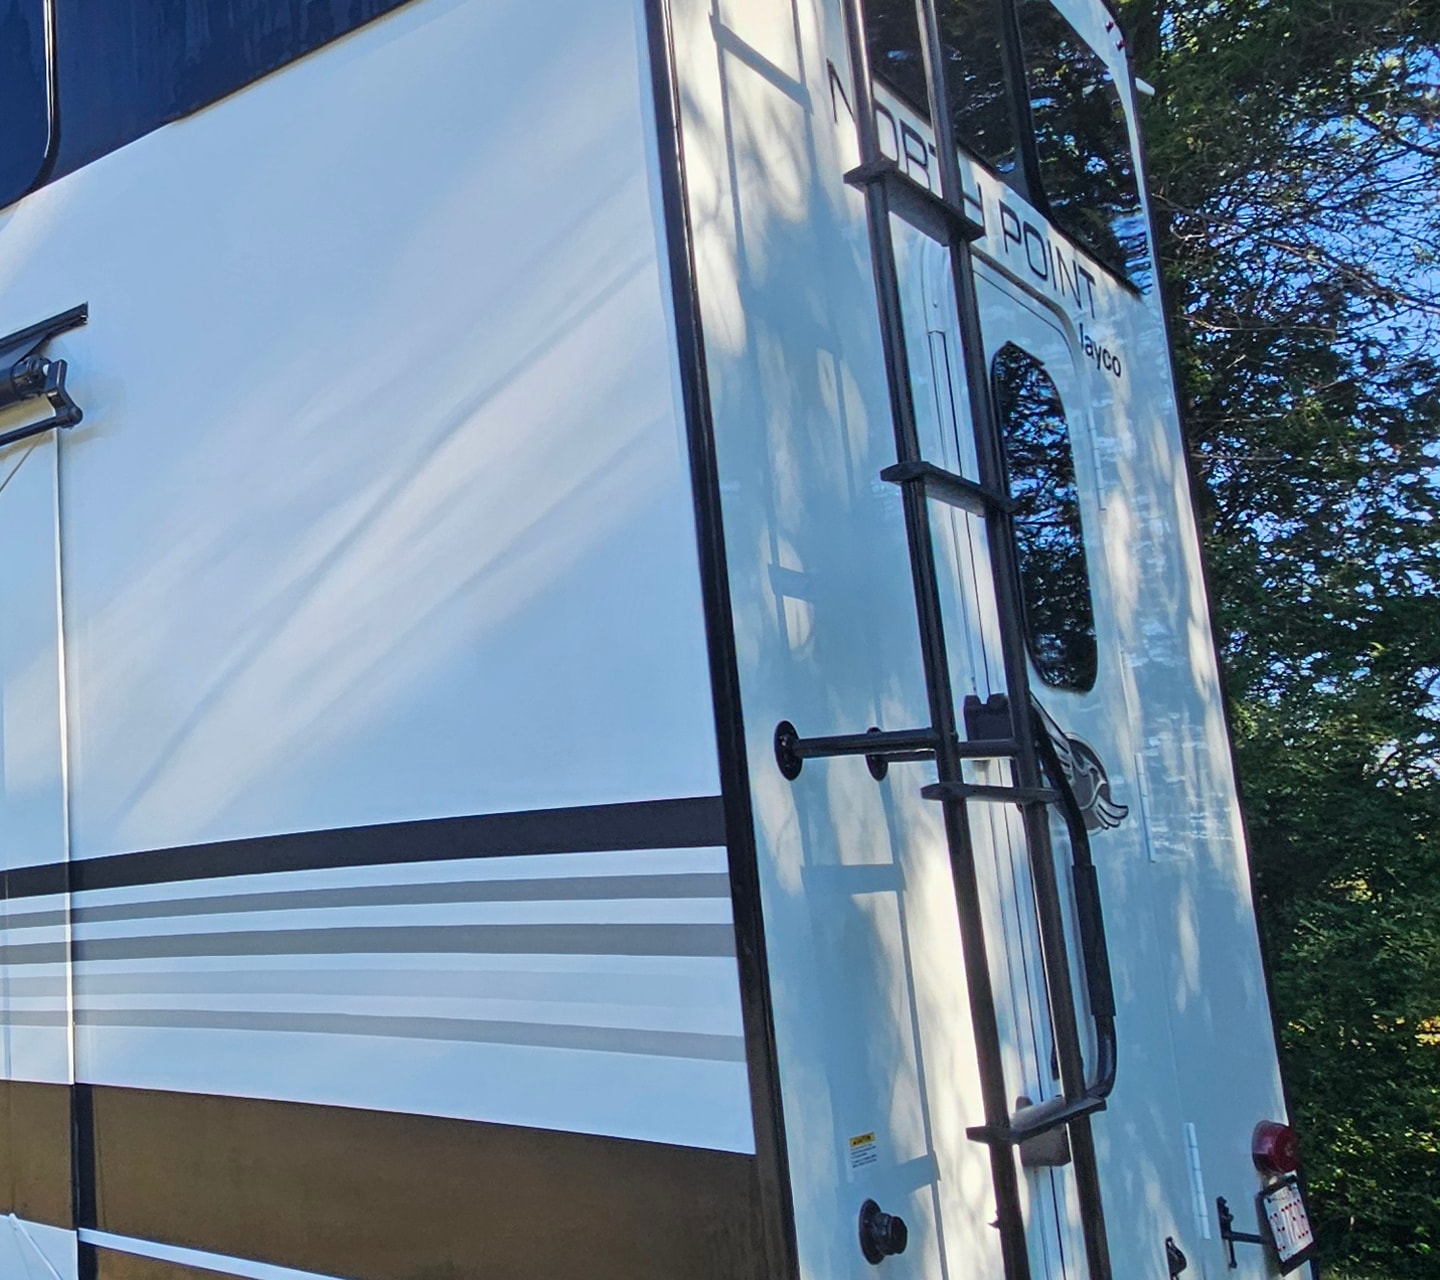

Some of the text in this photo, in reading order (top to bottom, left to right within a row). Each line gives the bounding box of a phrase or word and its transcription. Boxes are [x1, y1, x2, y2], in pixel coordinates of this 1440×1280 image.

[826, 58, 1096, 320] NORH POINT
[1078, 322, 1122, 378] Jayco
